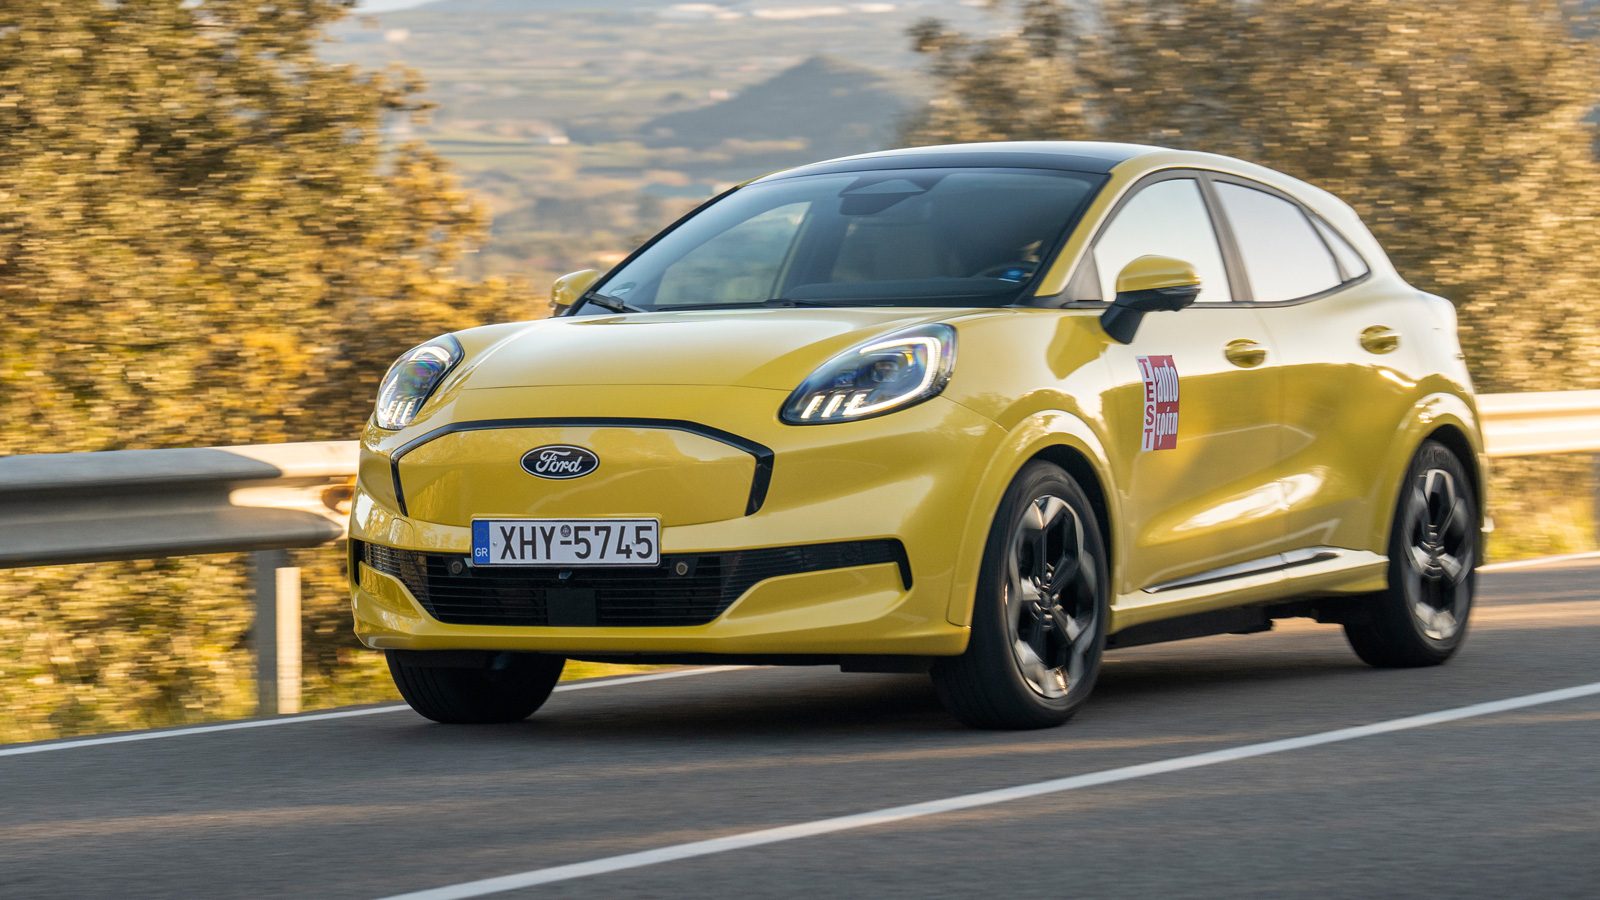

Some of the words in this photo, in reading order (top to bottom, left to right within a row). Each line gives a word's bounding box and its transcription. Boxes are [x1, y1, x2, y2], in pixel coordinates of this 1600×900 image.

[1154, 359, 1178, 403] auto
[1138, 358, 1154, 449] TEST
[535, 450, 582, 473] Ford
[475, 547, 488, 558] GR
